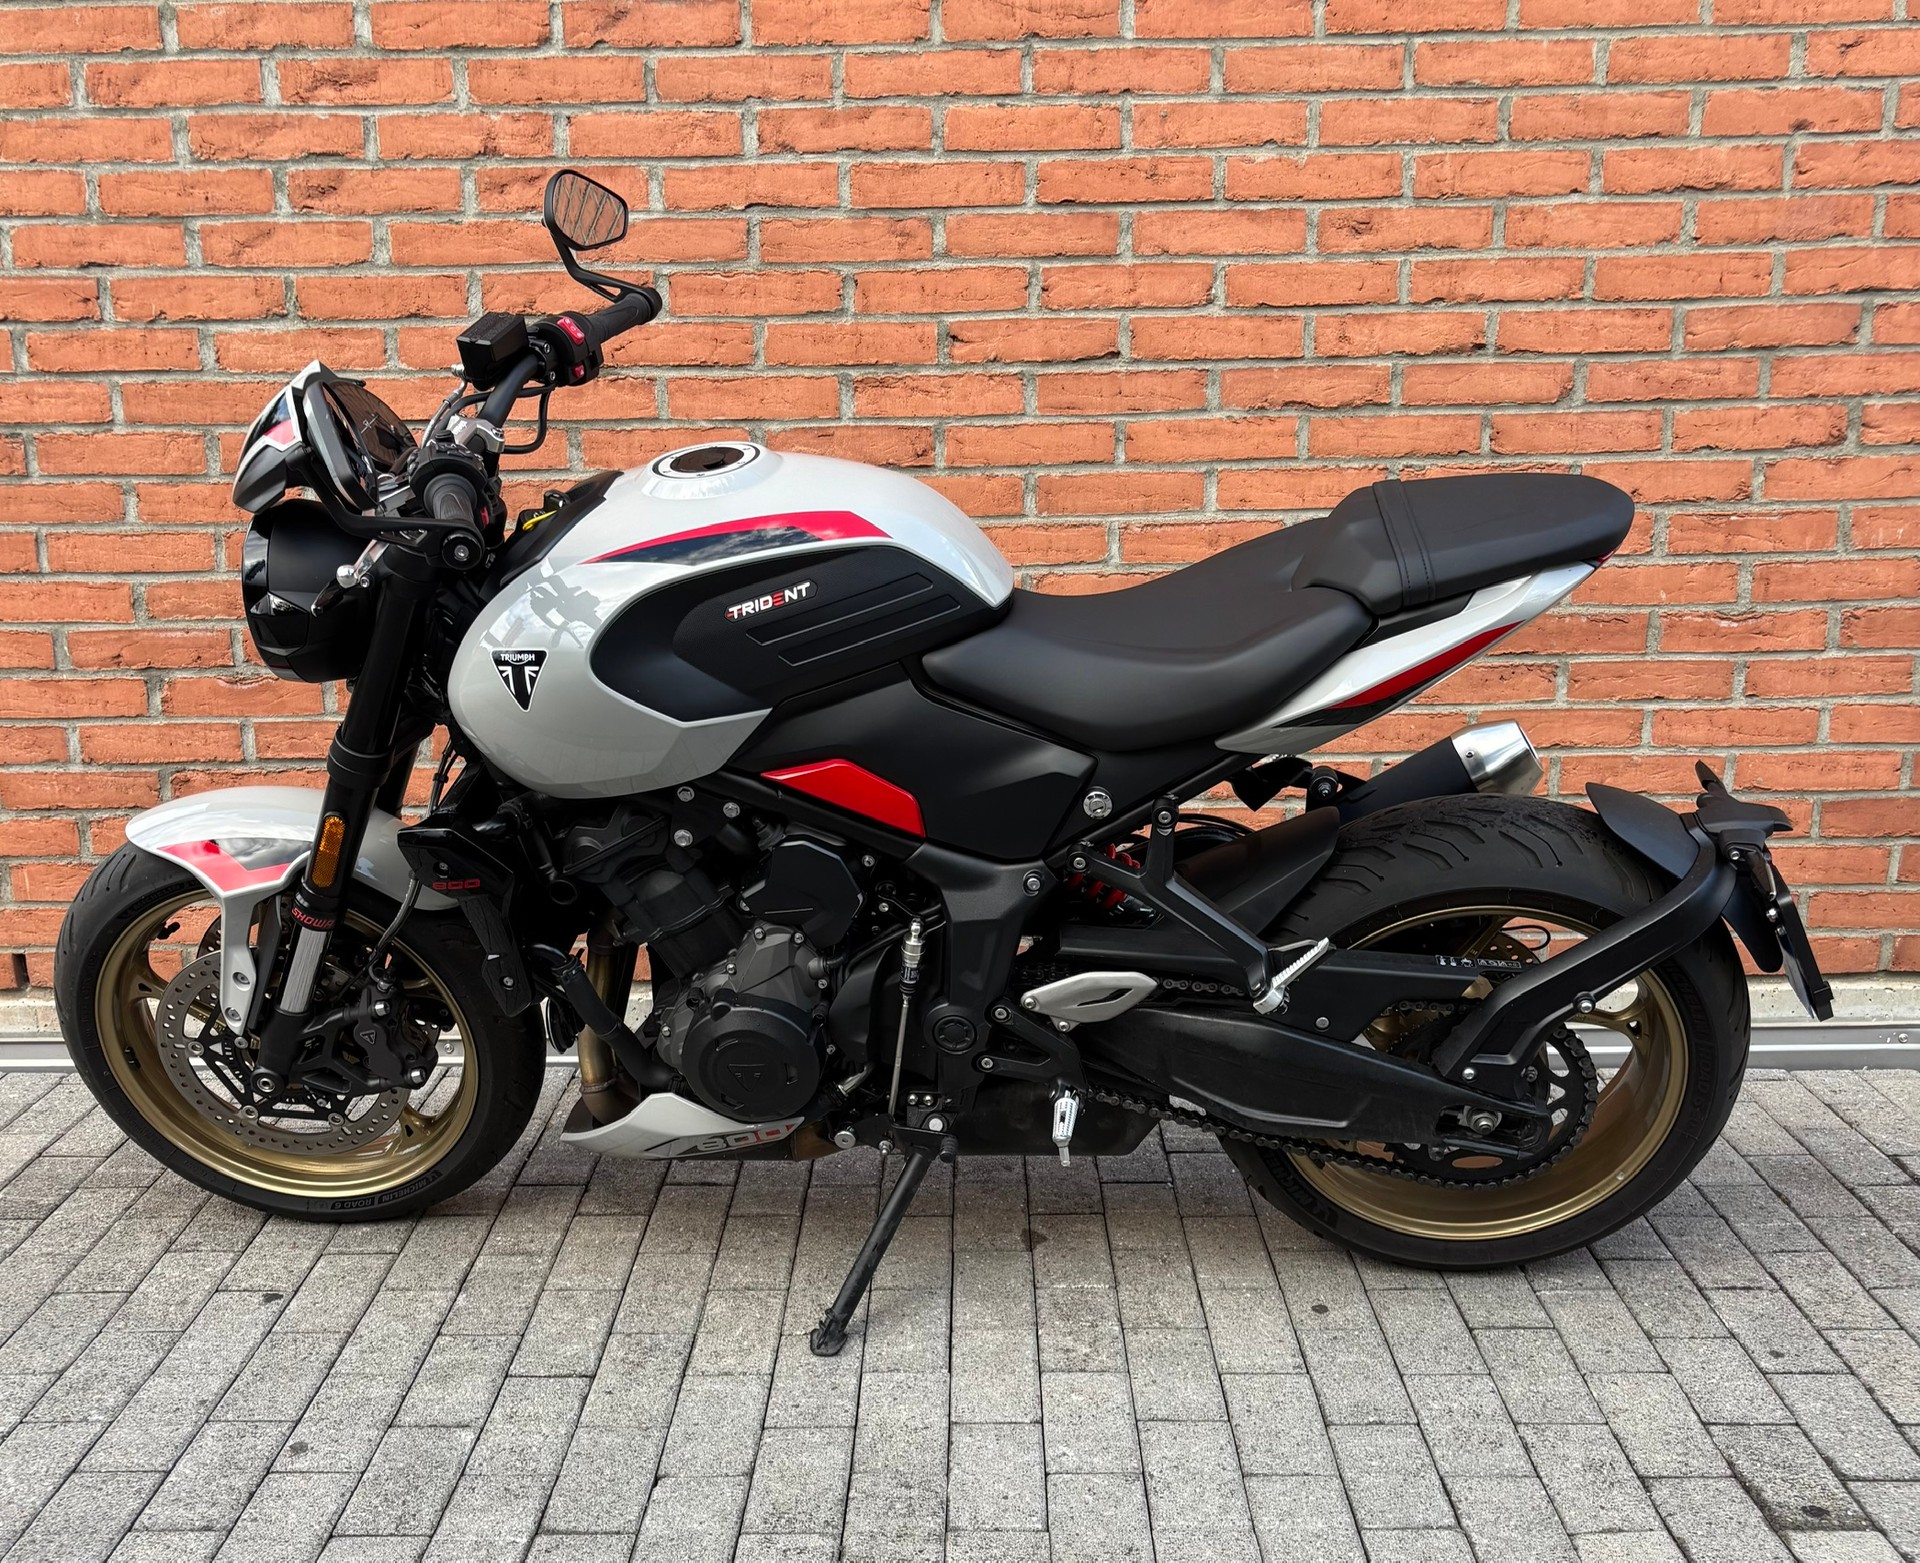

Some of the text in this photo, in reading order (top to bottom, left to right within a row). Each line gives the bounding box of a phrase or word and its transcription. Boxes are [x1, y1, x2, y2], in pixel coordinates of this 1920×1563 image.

[727, 582, 810, 619] TRIDENT
[500, 653, 535, 661] TRIUMPH
[382, 1177, 428, 1203] MICHELIN
[343, 1197, 372, 1209] ROAD
